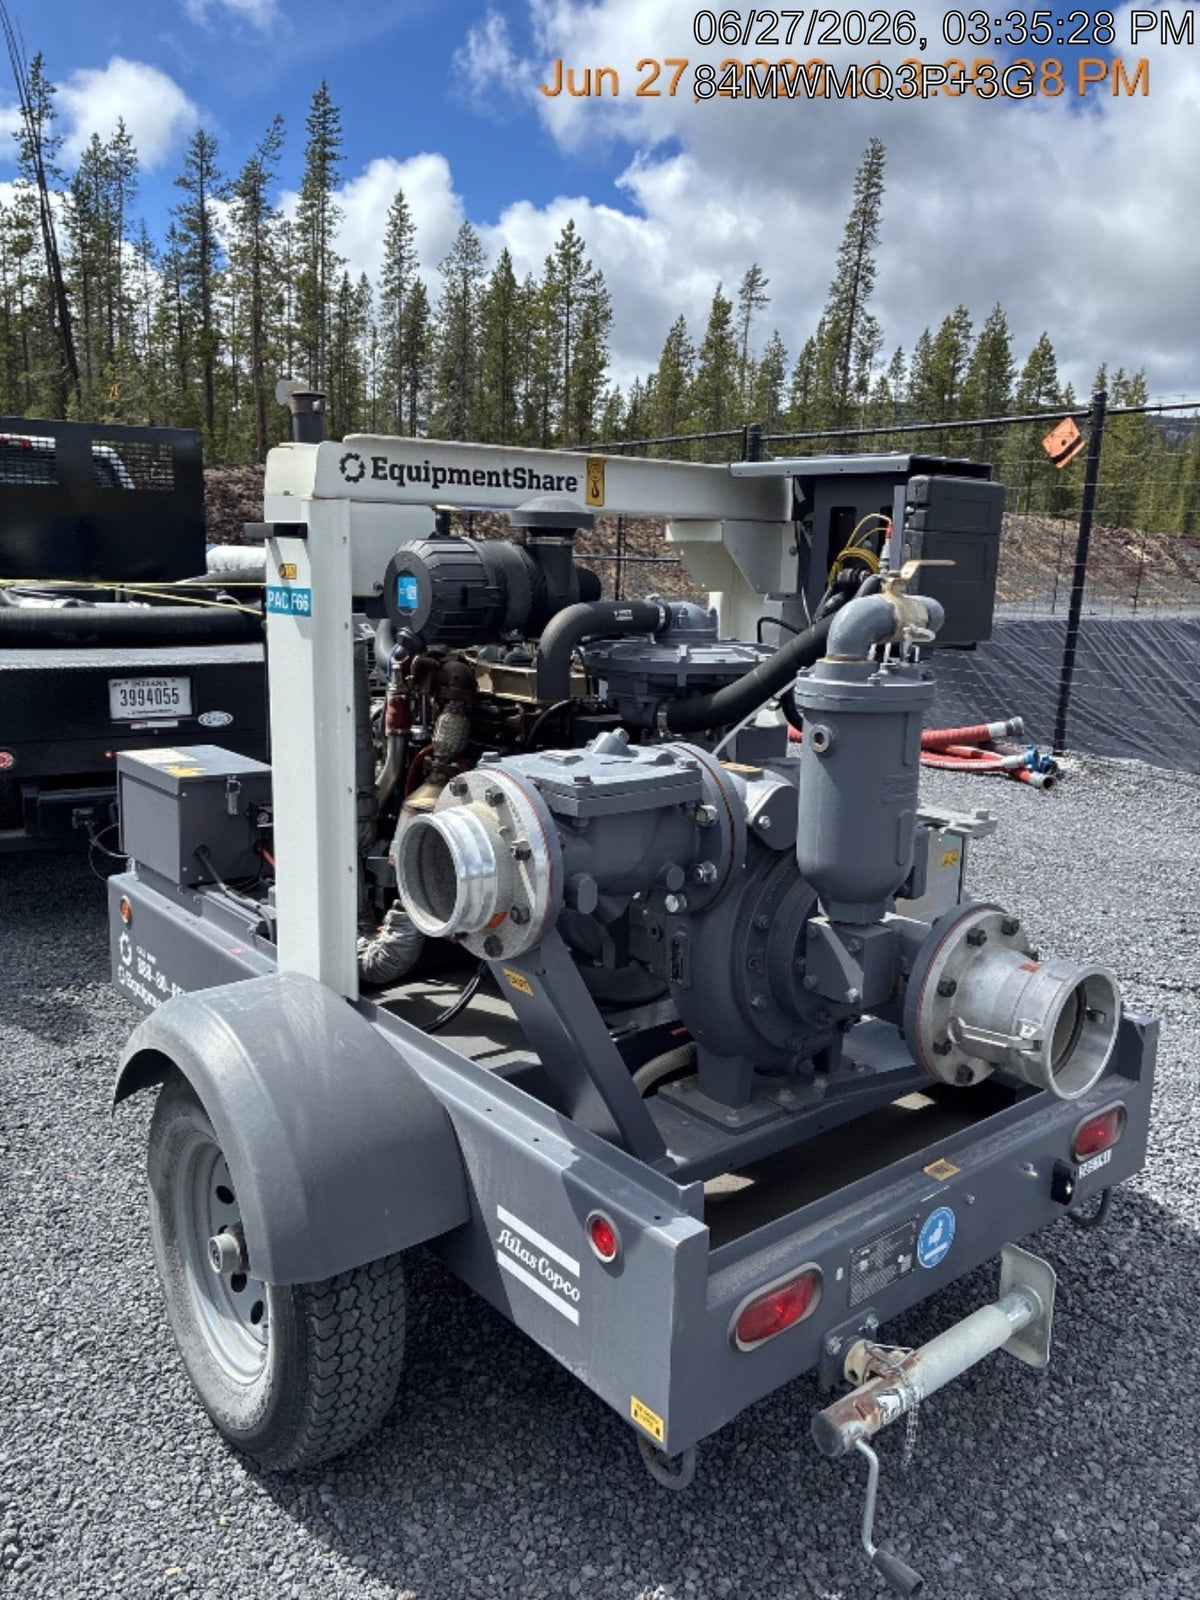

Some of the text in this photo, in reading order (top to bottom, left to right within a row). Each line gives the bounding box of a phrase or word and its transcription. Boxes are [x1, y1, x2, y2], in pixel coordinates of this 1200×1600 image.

[370, 456, 579, 493] EquipmentShare
[120, 687, 180, 707] 3994055
[496, 1229, 580, 1302] Atlas Copco
